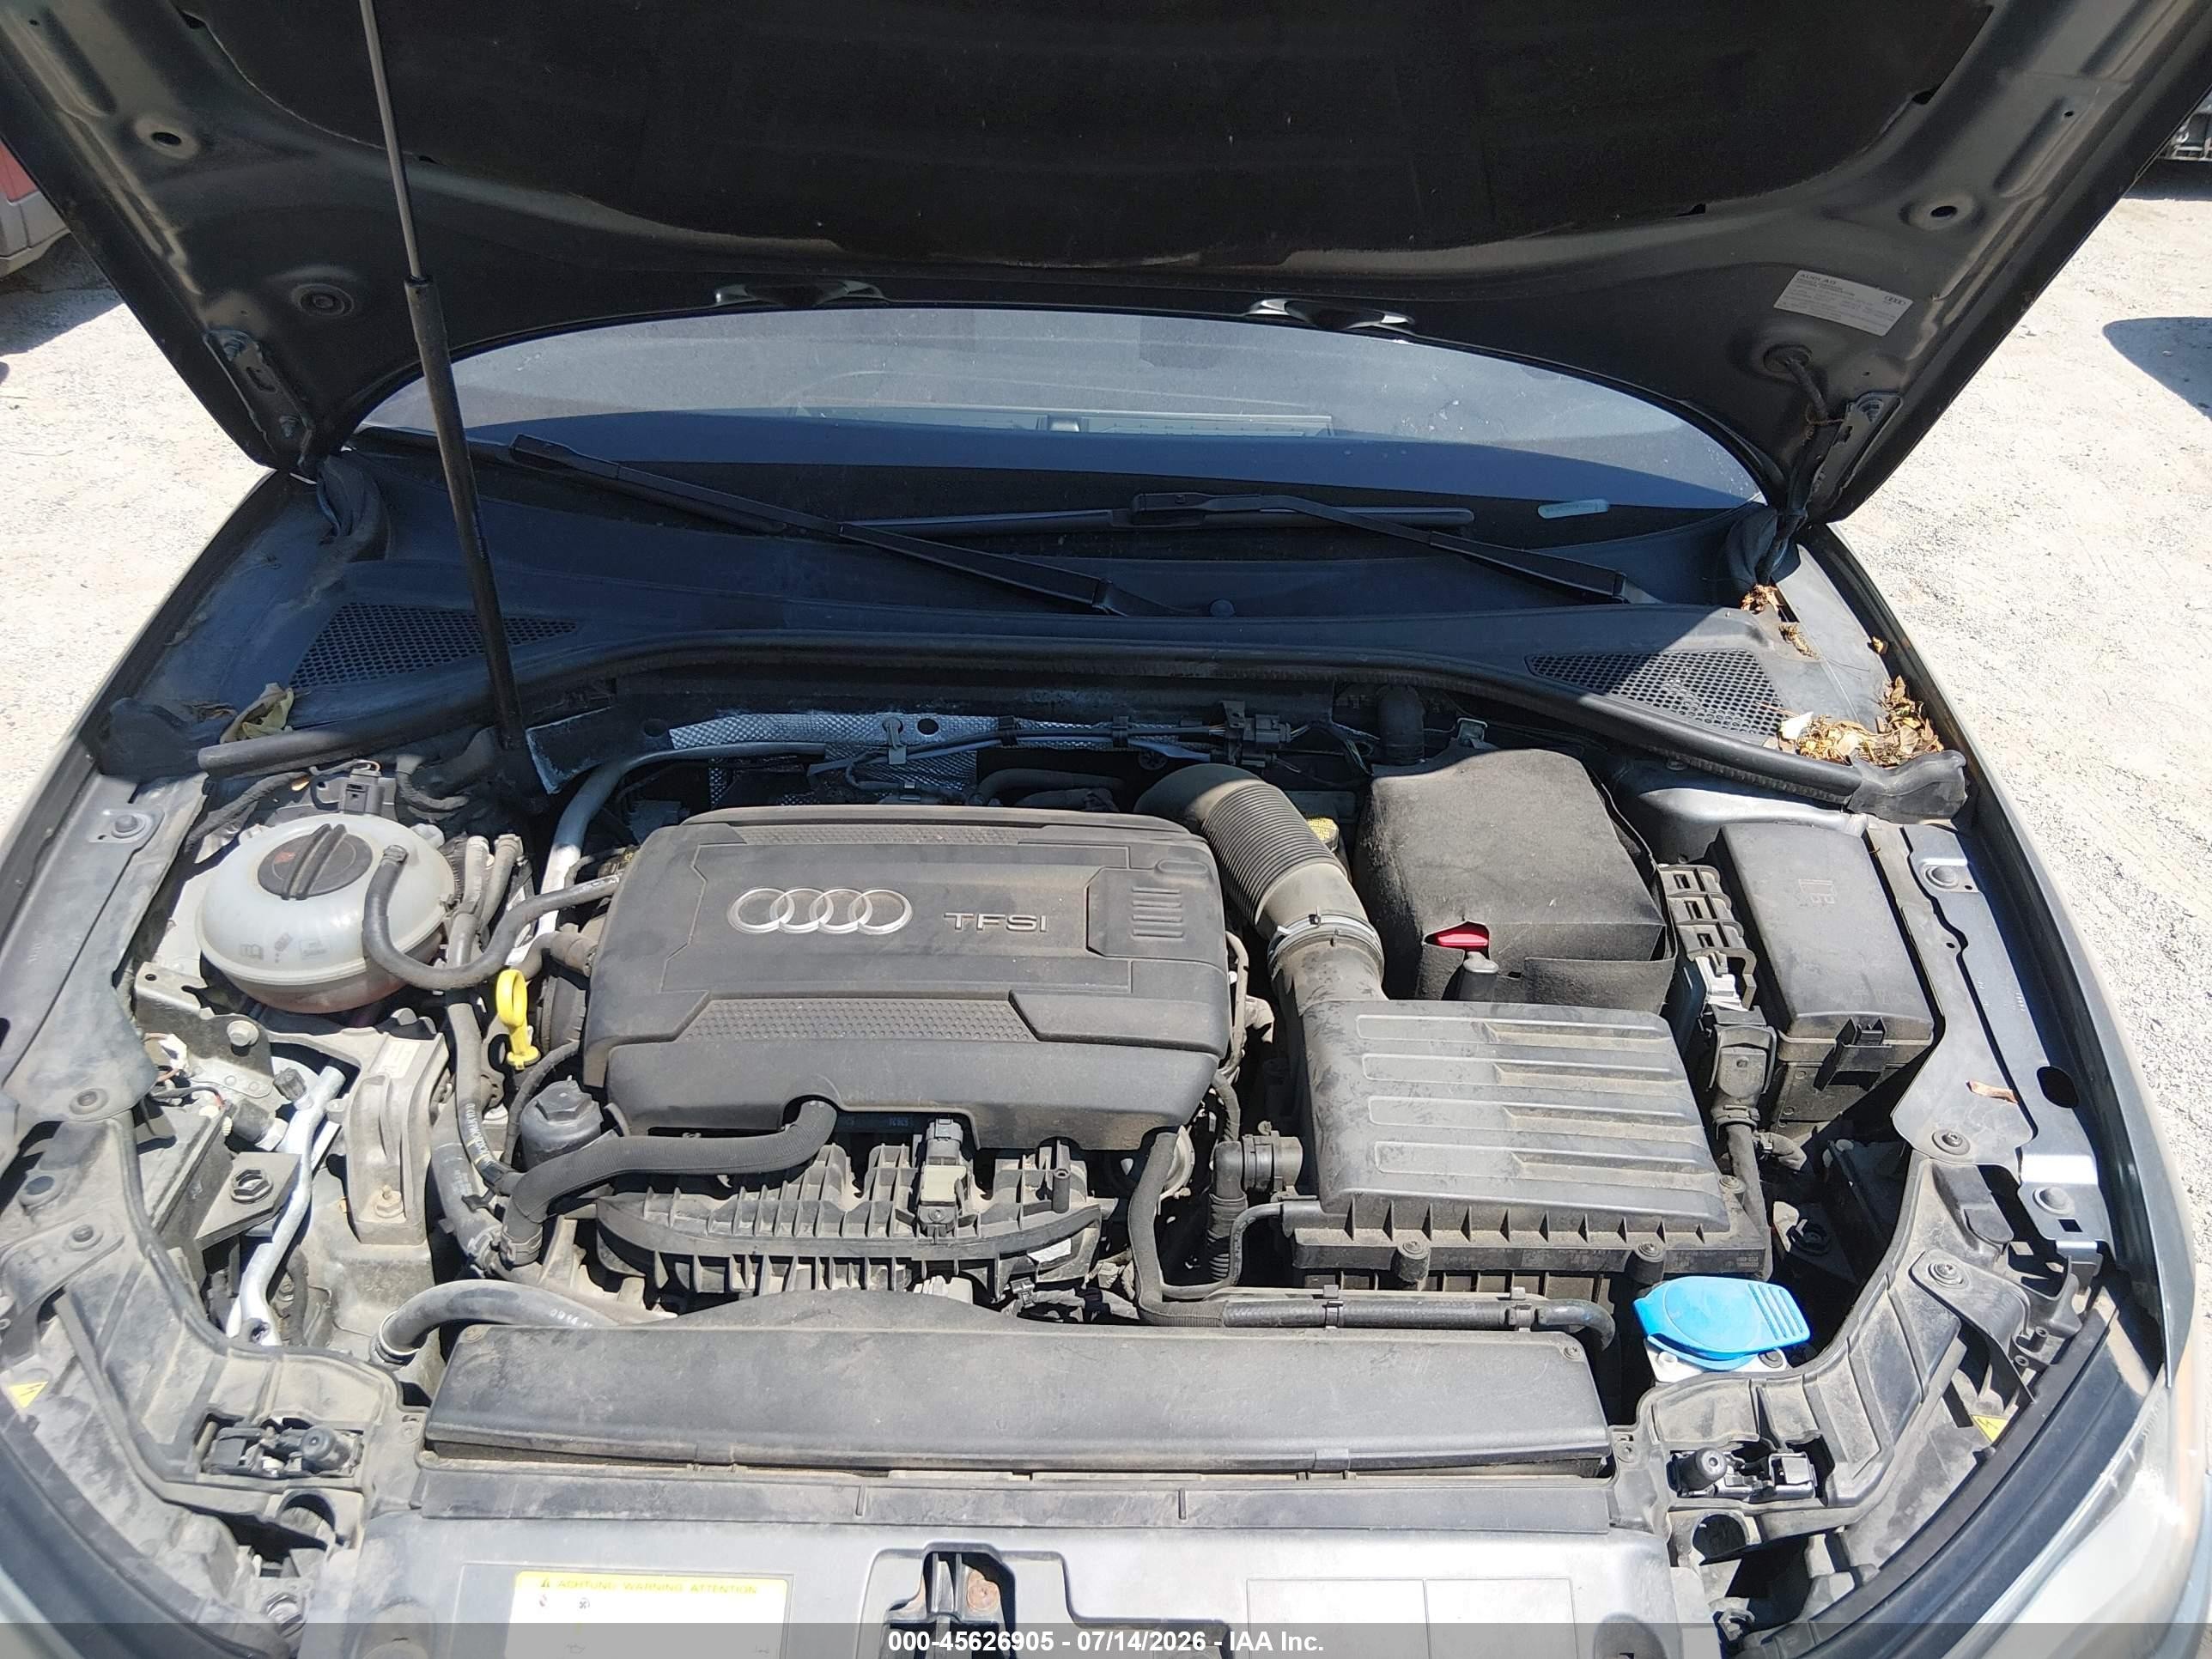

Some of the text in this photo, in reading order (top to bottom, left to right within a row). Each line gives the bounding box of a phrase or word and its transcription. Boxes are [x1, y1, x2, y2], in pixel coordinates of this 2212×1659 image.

[944, 912, 1048, 933] TFSI
[623, 1581, 684, 1592] WARNING
[690, 1583, 757, 1595] ATTENTION
